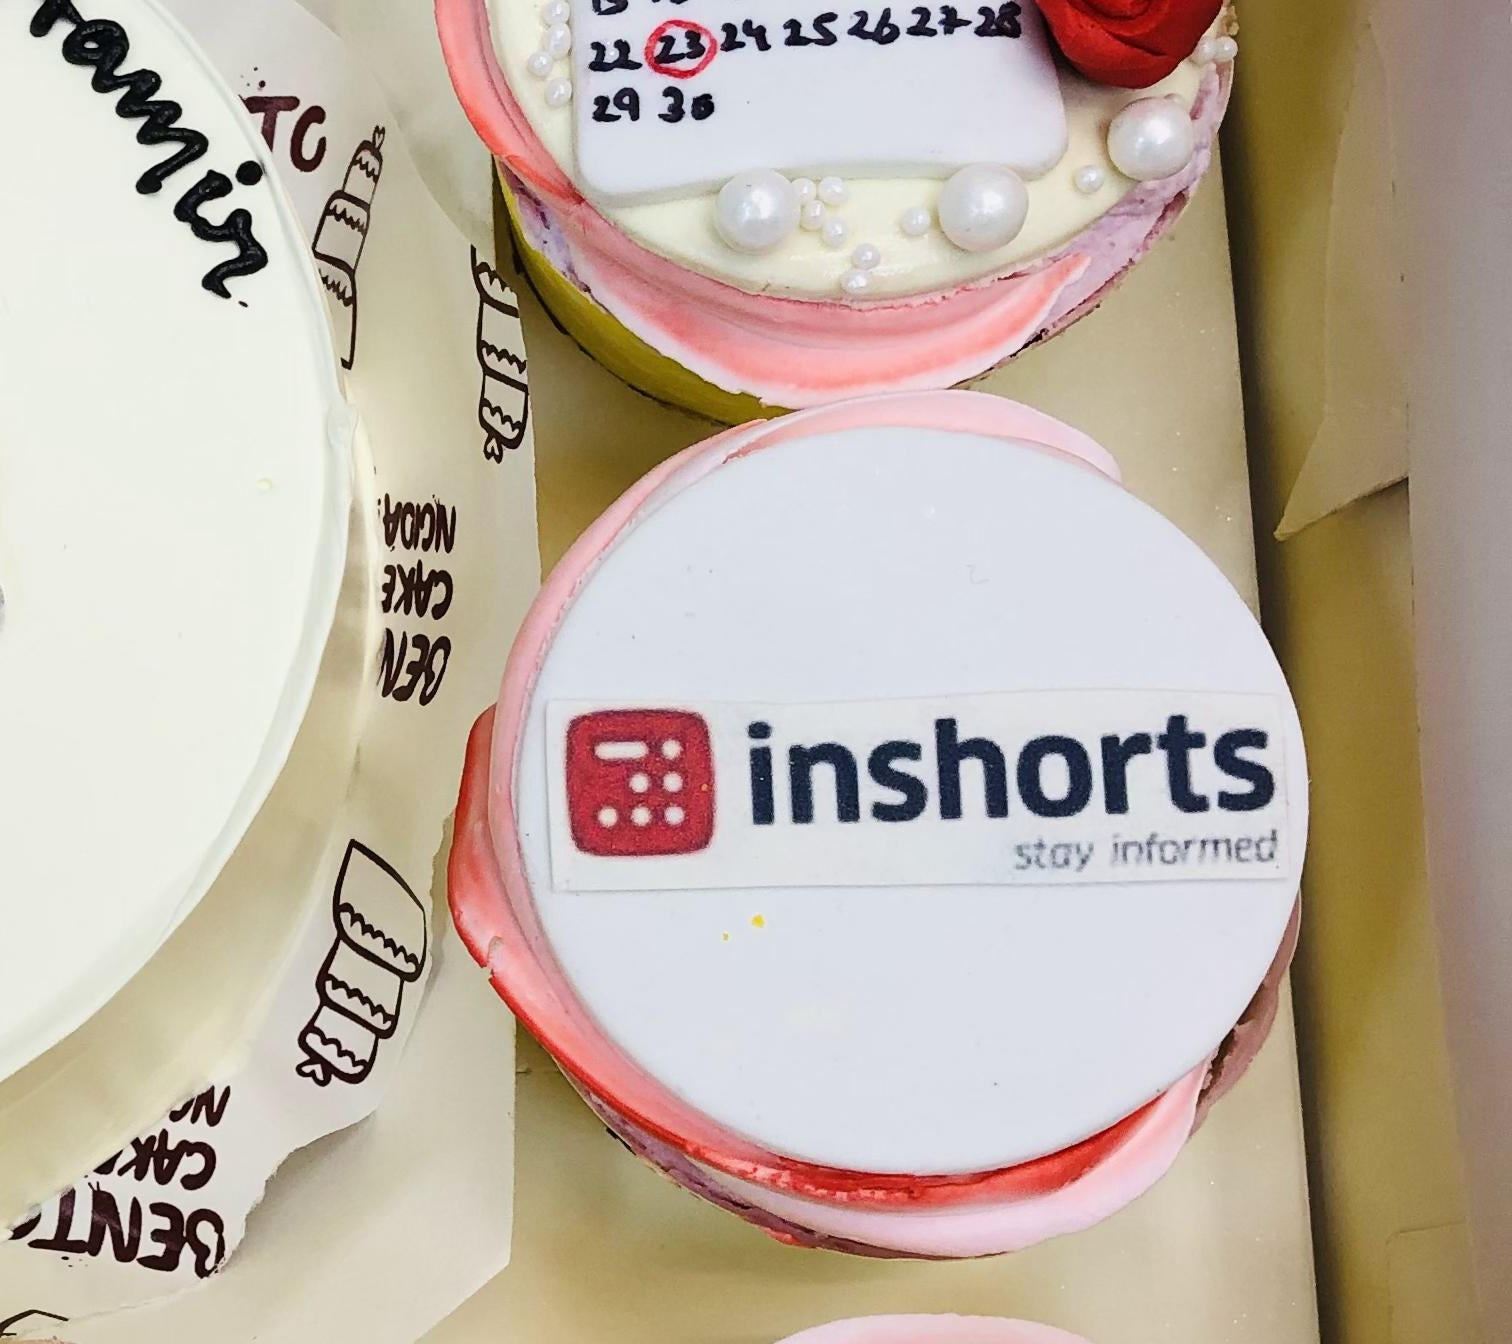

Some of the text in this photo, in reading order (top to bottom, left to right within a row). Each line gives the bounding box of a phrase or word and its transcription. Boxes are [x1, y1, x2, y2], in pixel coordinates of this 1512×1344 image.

[589, 0, 1025, 72] 22 23 24 25 26 27 28
[592, 86, 714, 123] 29 30
[382, 560, 453, 620] CAKE
[749, 715, 1274, 824] inshorts
[1016, 829, 1277, 871] stay informed
